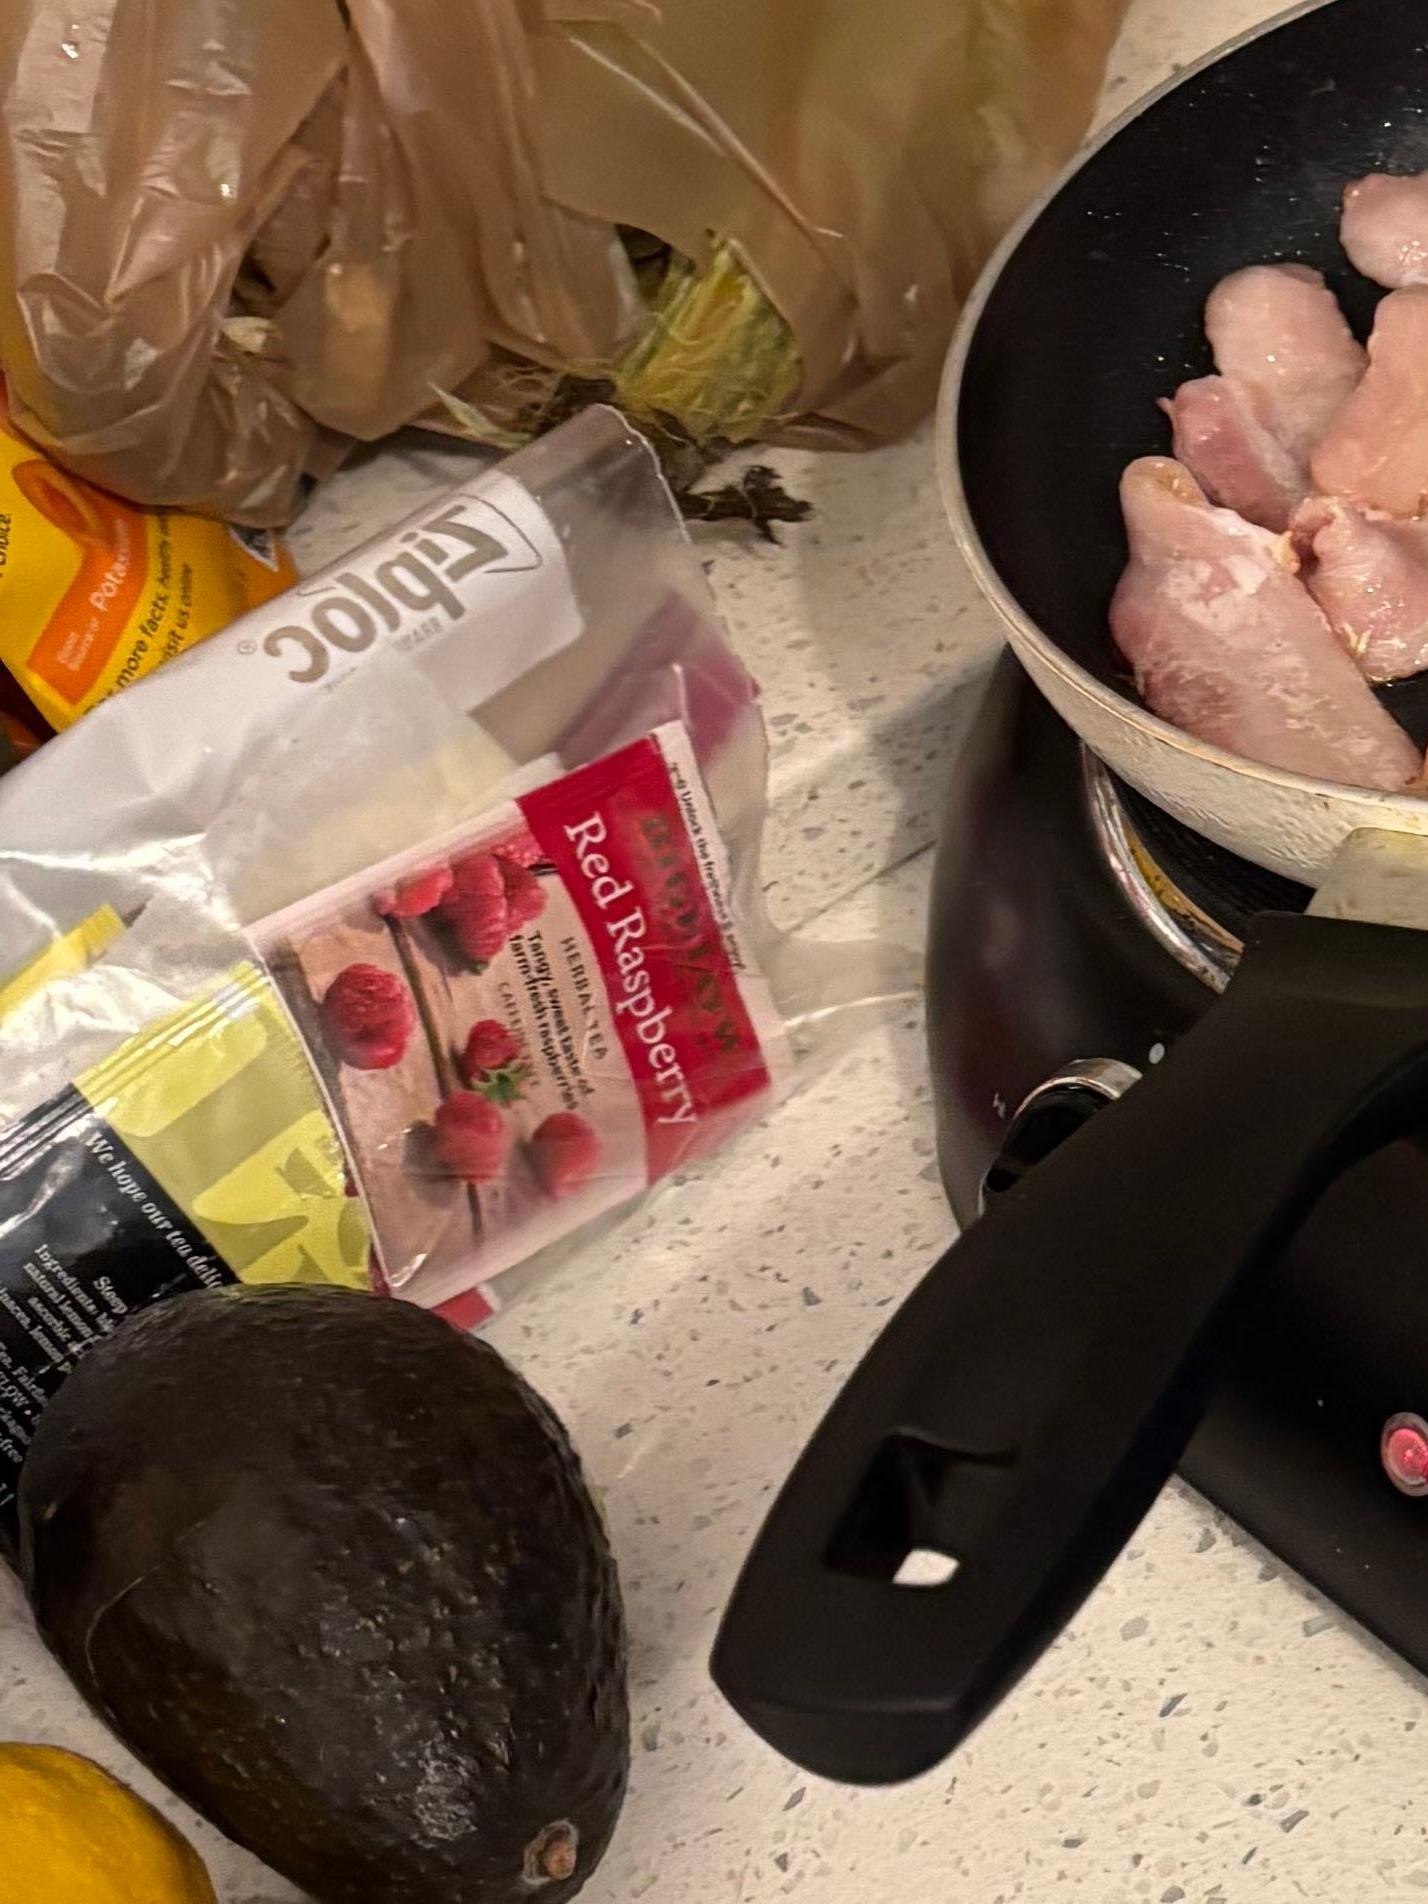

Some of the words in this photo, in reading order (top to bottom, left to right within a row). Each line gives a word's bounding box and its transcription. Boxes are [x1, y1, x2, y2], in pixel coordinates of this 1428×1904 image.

[527, 929, 555, 988] Tangy,
[560, 935, 596, 1015] HERBAL
[563, 810, 635, 910] Red
[606, 906, 698, 1126] Raspberry
[85, 1133, 115, 1165] We
[107, 1160, 149, 1204] hope
[141, 1202, 174, 1231] our
[165, 1229, 194, 1259] tea
